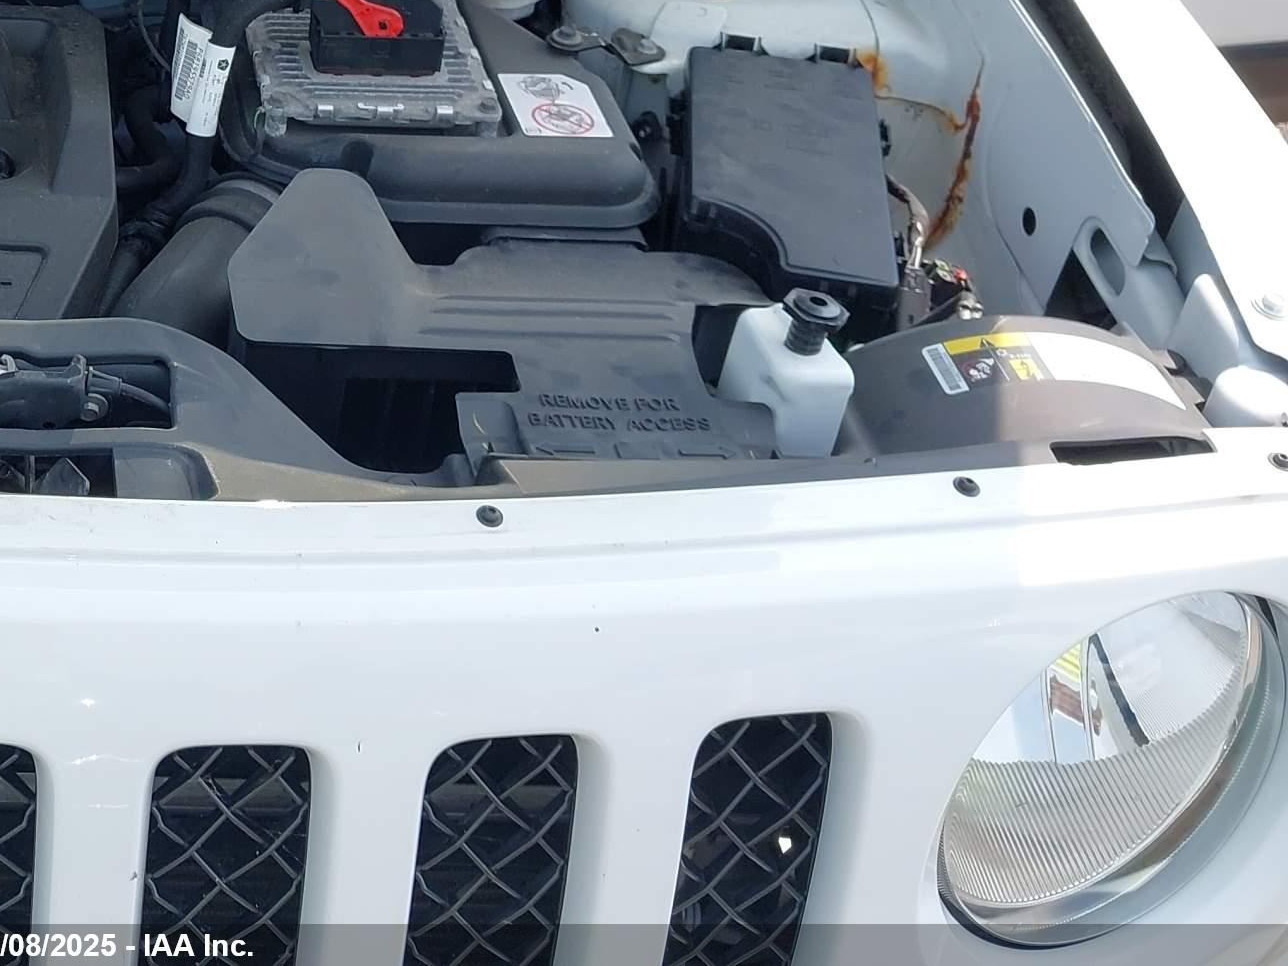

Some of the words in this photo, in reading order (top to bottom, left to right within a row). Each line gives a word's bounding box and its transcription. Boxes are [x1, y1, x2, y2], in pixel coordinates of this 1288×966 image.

[539, 393, 629, 411] REMOVE
[634, 397, 681, 412] FOR
[527, 412, 616, 430] BATTERY
[625, 417, 712, 432] ACCESS
